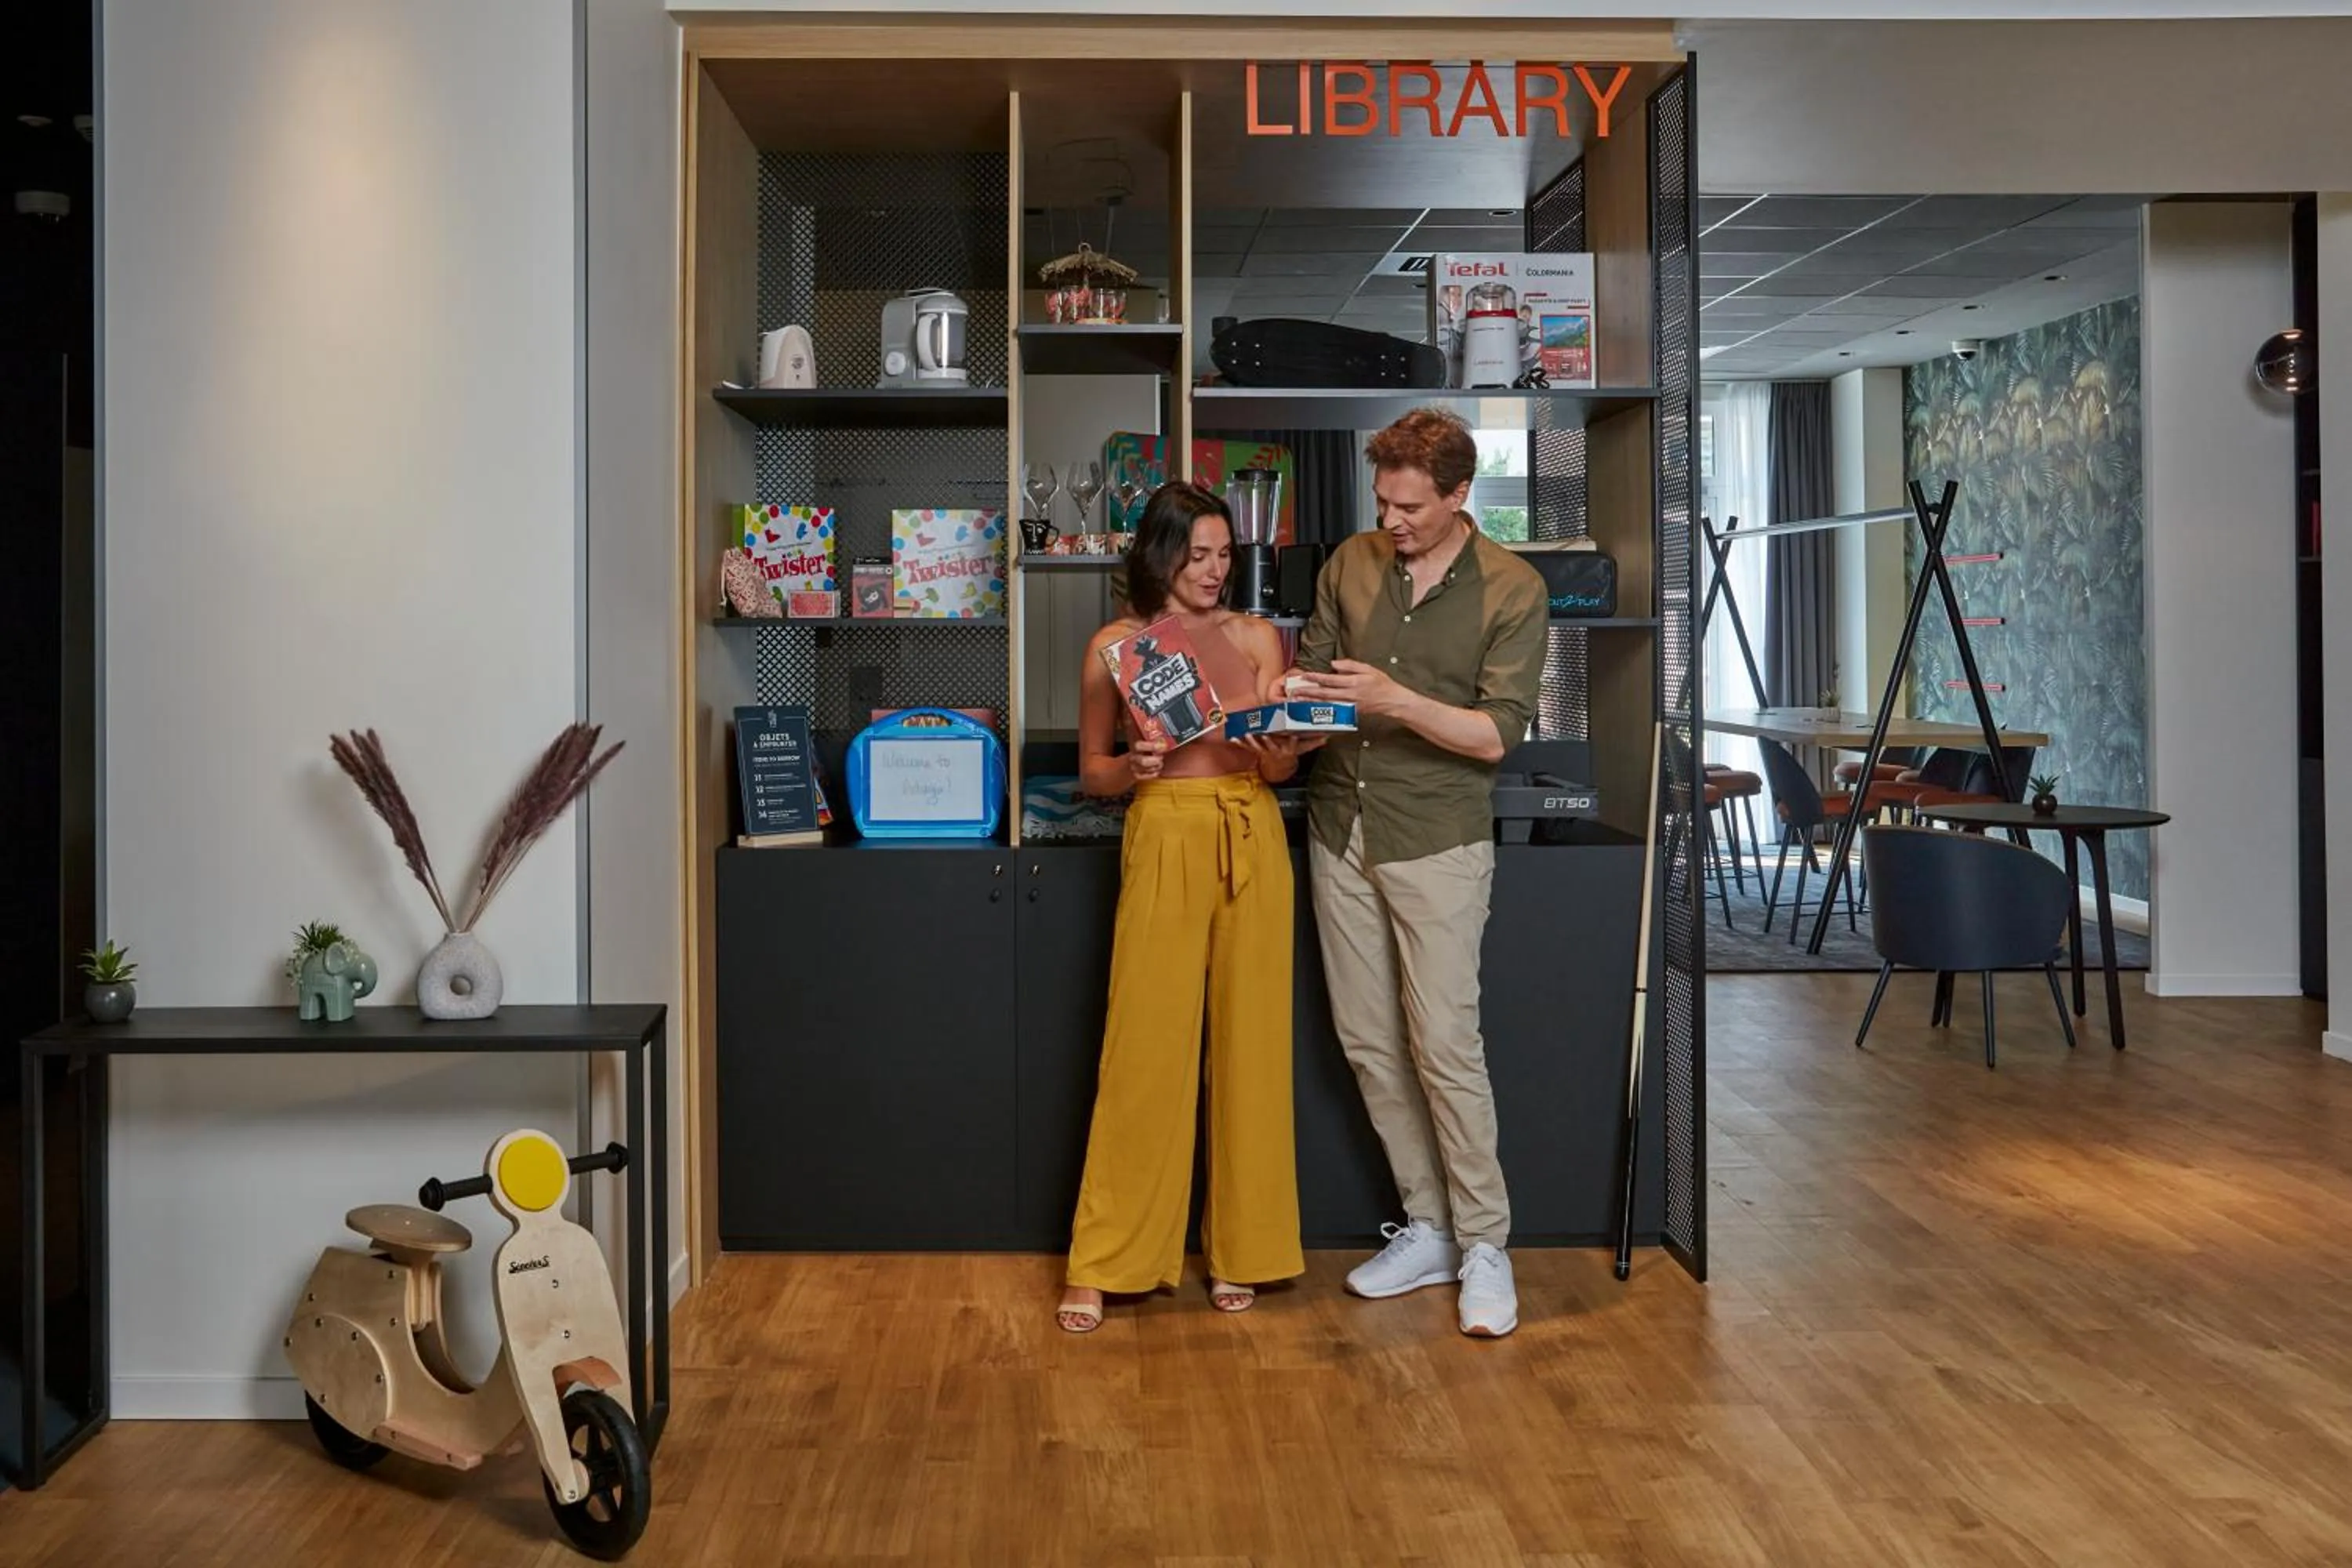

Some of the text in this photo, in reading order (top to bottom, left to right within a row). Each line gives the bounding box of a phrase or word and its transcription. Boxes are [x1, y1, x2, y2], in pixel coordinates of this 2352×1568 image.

[1246, 60, 1632, 137] LIBRARY
[1446, 263, 1509, 277] Tefal
[753, 552, 826, 580] Twister
[902, 554, 993, 586] Twister
[1138, 659, 1184, 695] CODE
[1145, 672, 1196, 711] NAMES
